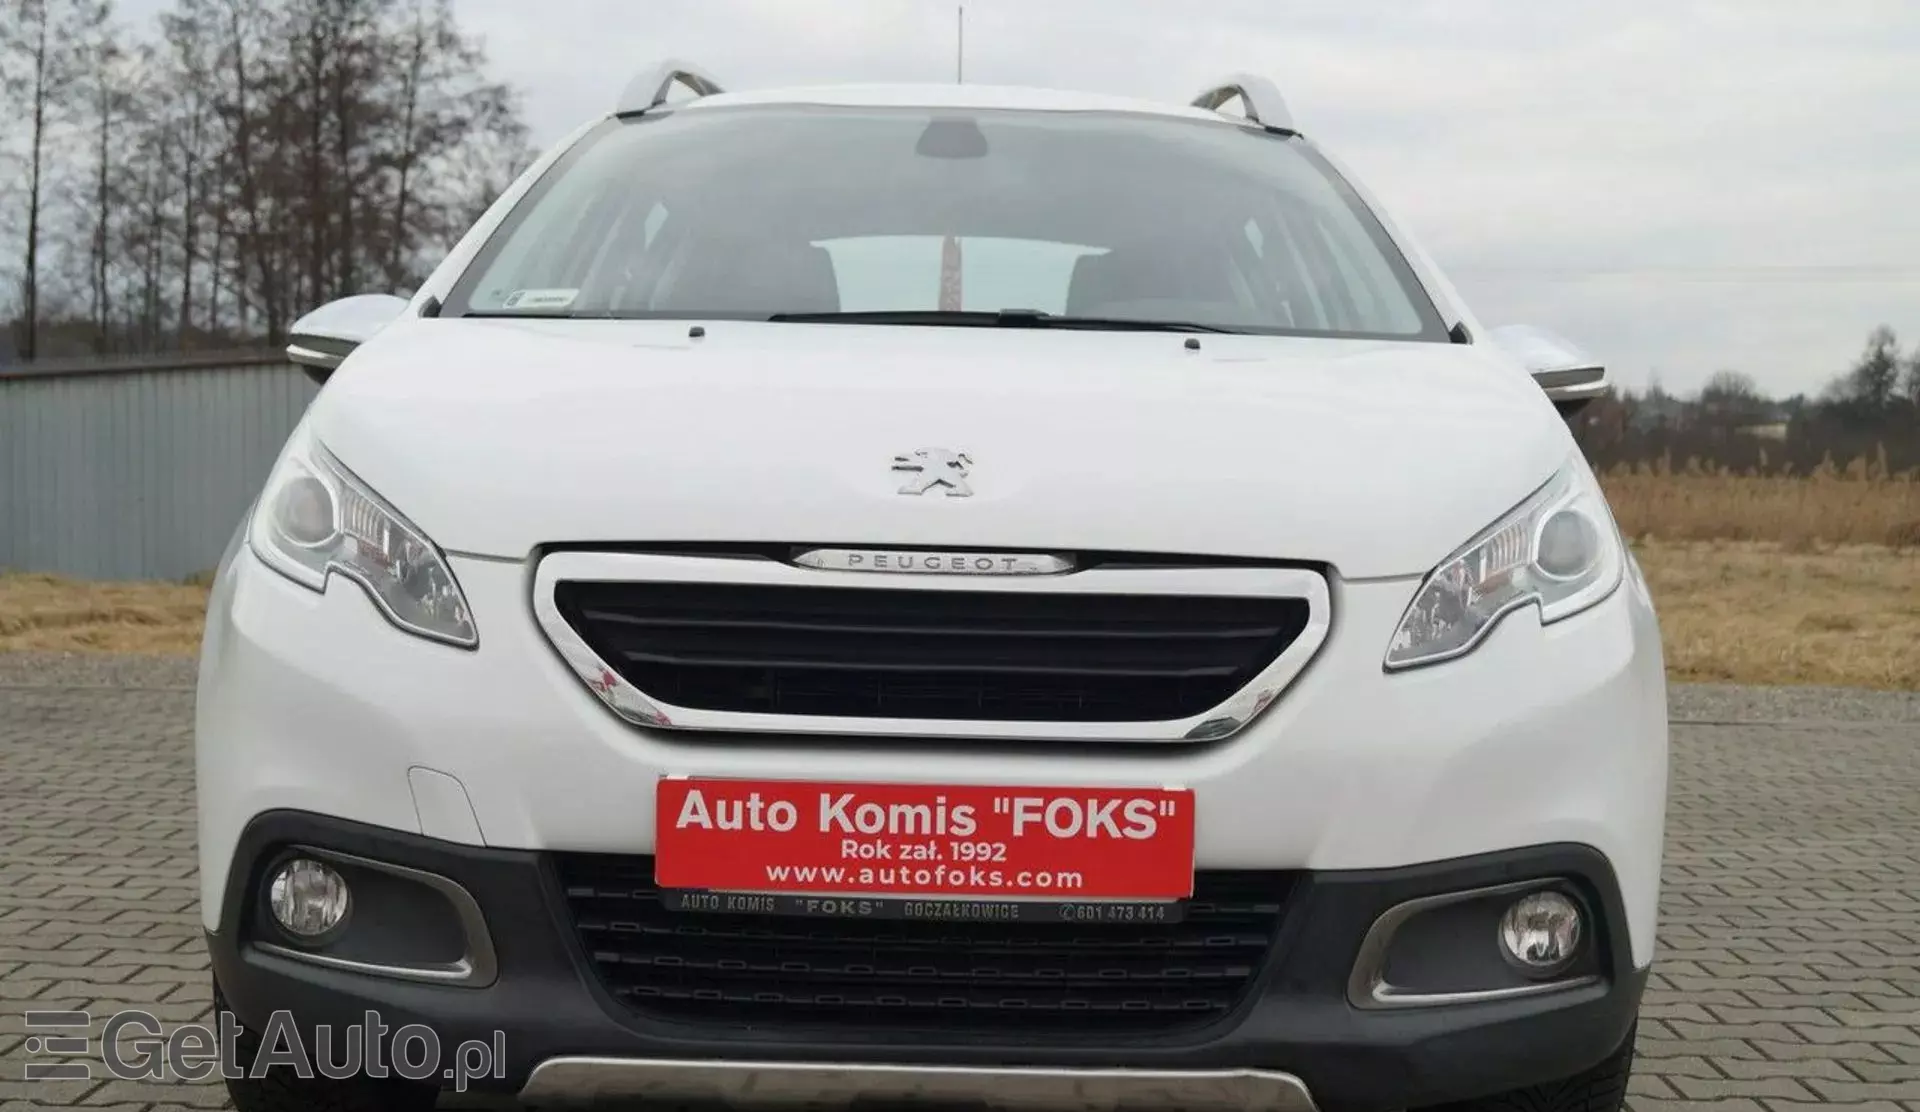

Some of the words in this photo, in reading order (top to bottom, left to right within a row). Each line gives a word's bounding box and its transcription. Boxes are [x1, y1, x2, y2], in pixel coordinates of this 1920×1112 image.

[848, 553, 1017, 571] PEUGEOT
[675, 789, 798, 832] Auto
[819, 793, 977, 836] Komis
[994, 796, 1176, 840] "FOKS"
[841, 839, 891, 859] Rok
[899, 840, 943, 861] zał.
[950, 842, 1007, 862] 1992
[766, 865, 1083, 888] www.autofoks.com
[680, 894, 719, 909] AUTO
[727, 896, 775, 912] KOMIS
[795, 899, 884, 915] "FOKS"
[904, 902, 1020, 919] GOCZAŁKOWICE
[1107, 905, 1135, 921] 473
[1138, 906, 1165, 922] 414
